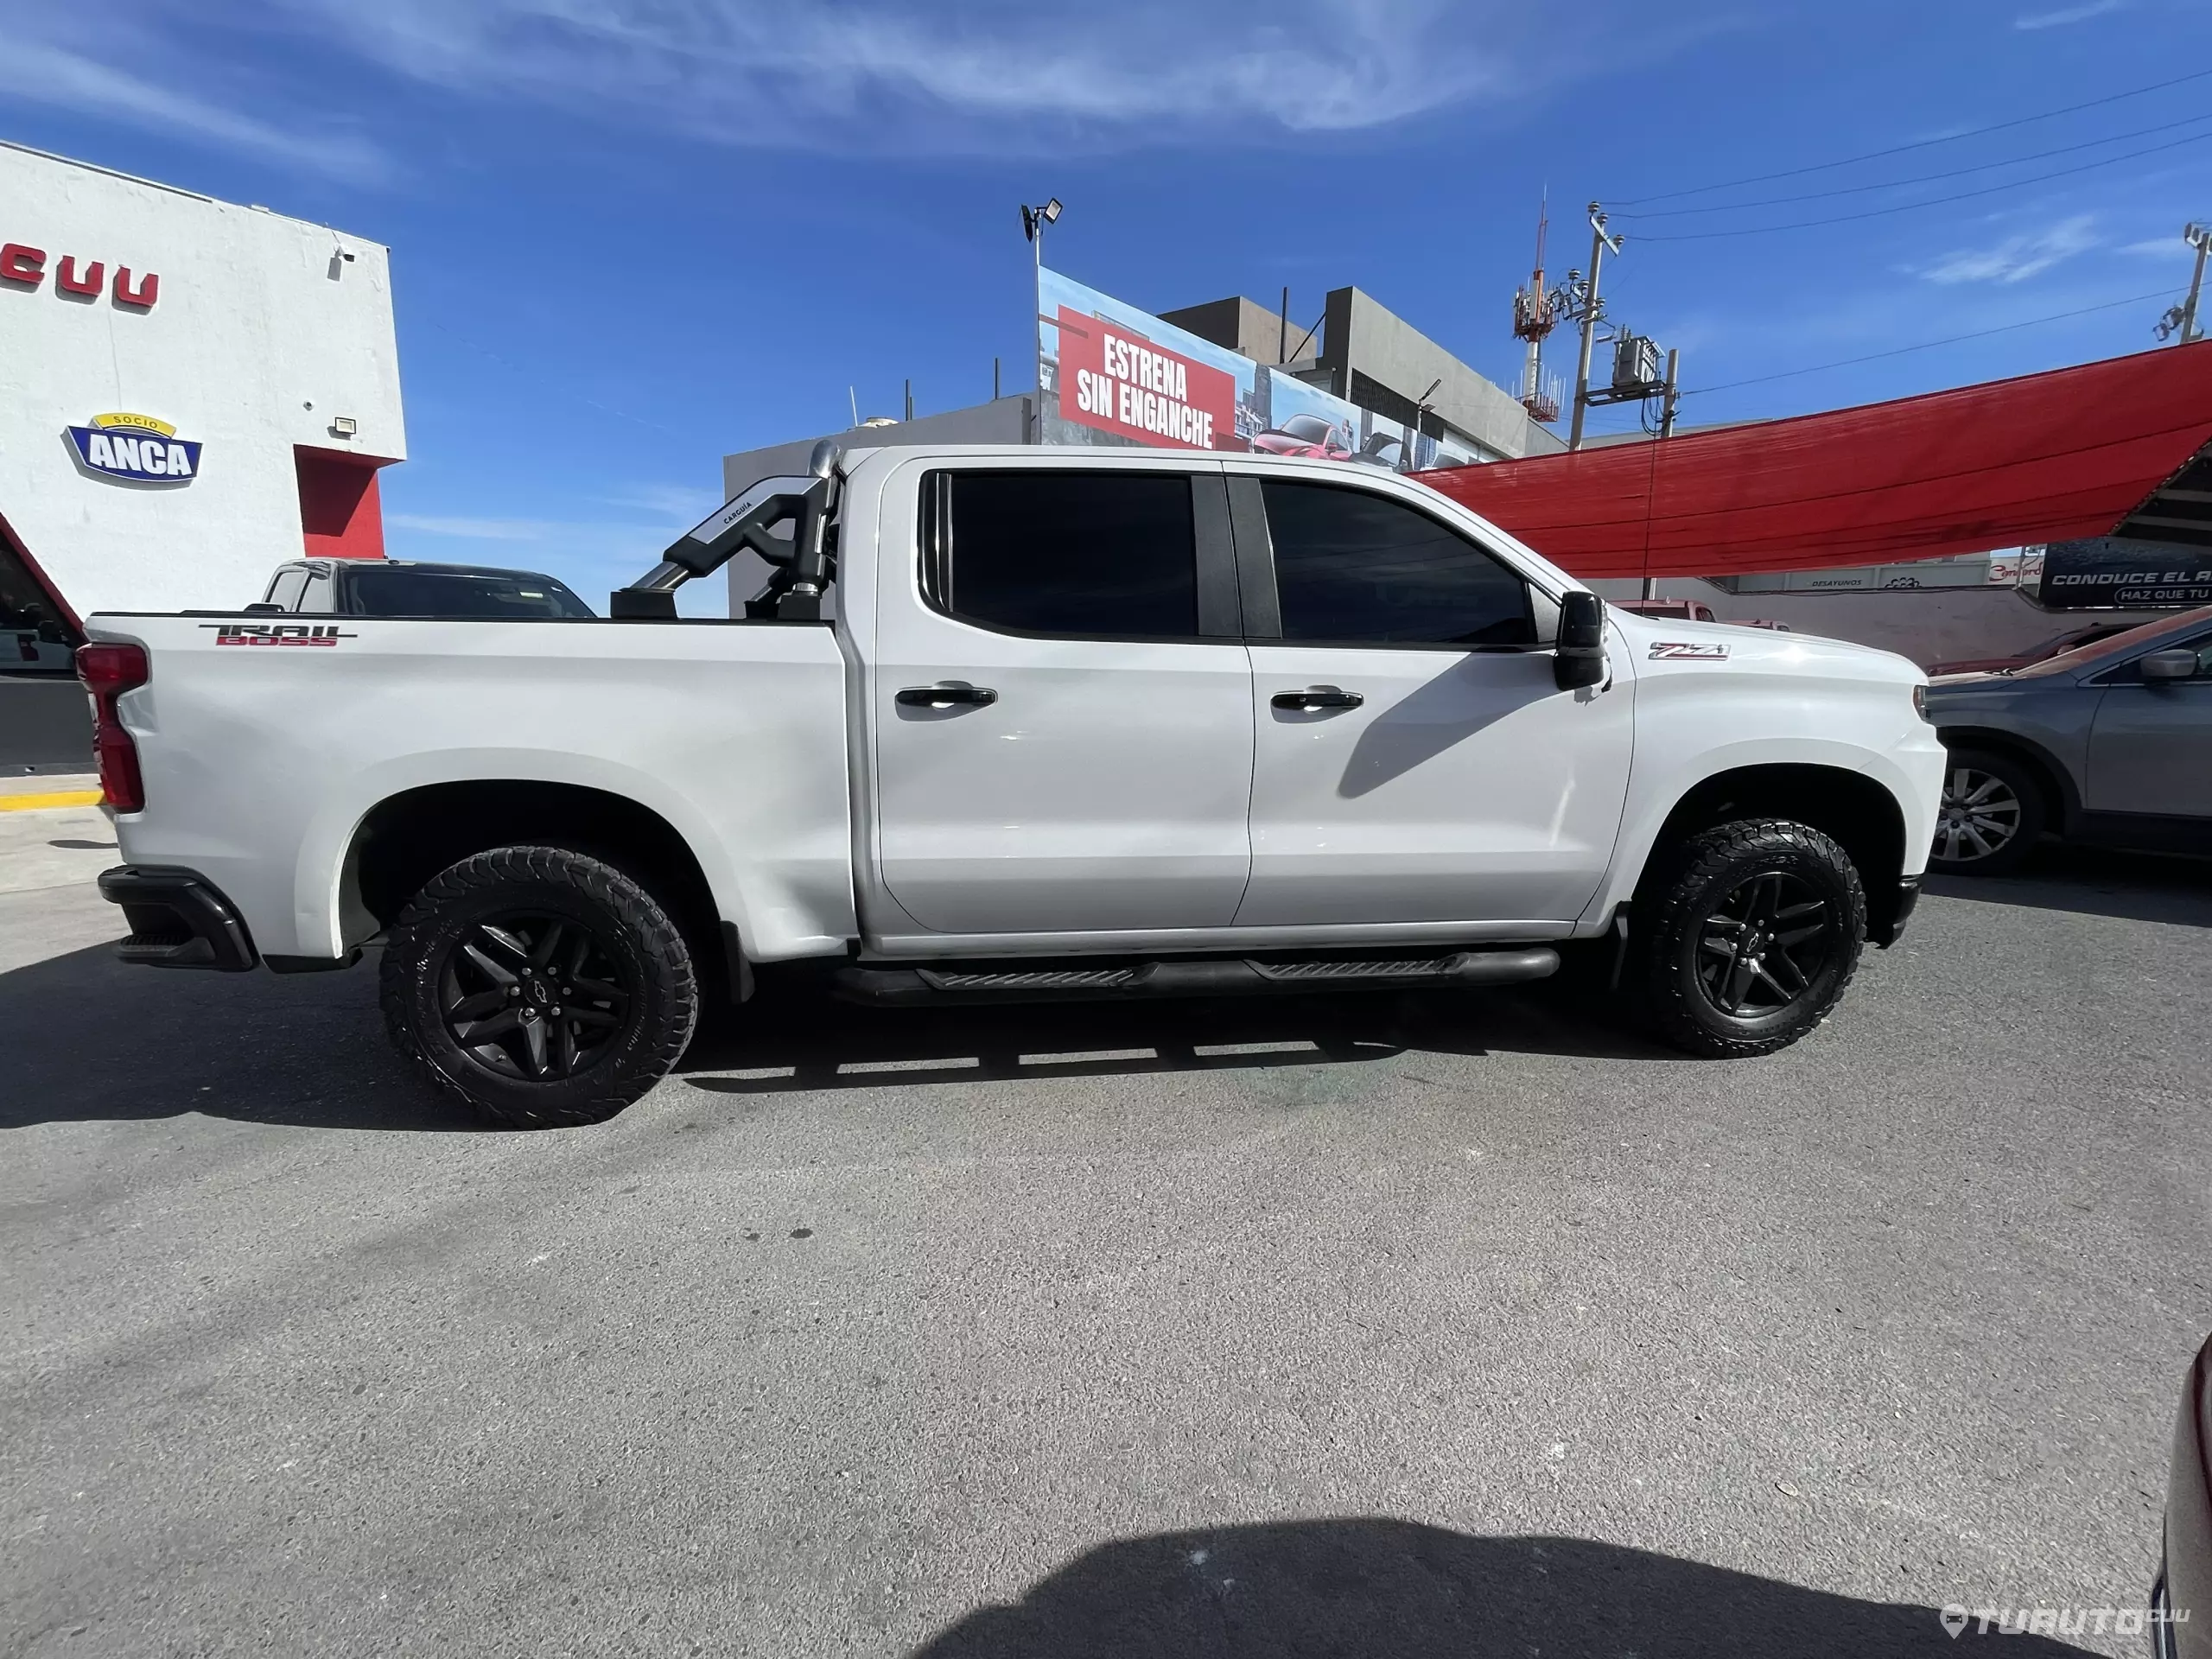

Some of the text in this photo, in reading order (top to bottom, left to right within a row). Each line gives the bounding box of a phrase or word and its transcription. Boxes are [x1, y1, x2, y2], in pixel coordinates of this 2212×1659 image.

[0, 243, 159, 308] CUU
[1103, 333, 1187, 402] ESTRENA
[1077, 369, 1213, 449] SIN ENGANCHE
[113, 416, 158, 429] SOCIO
[89, 433, 193, 476] ANCA
[1812, 579, 1862, 588] DESAYUNOS
[2052, 570, 2212, 586] CONDUCE EL A
[2121, 588, 2209, 601] HAZ QUE TU
[198, 625, 358, 638] TRAIL
[216, 636, 338, 646] BOSS
[1648, 641, 1731, 661] Z71
